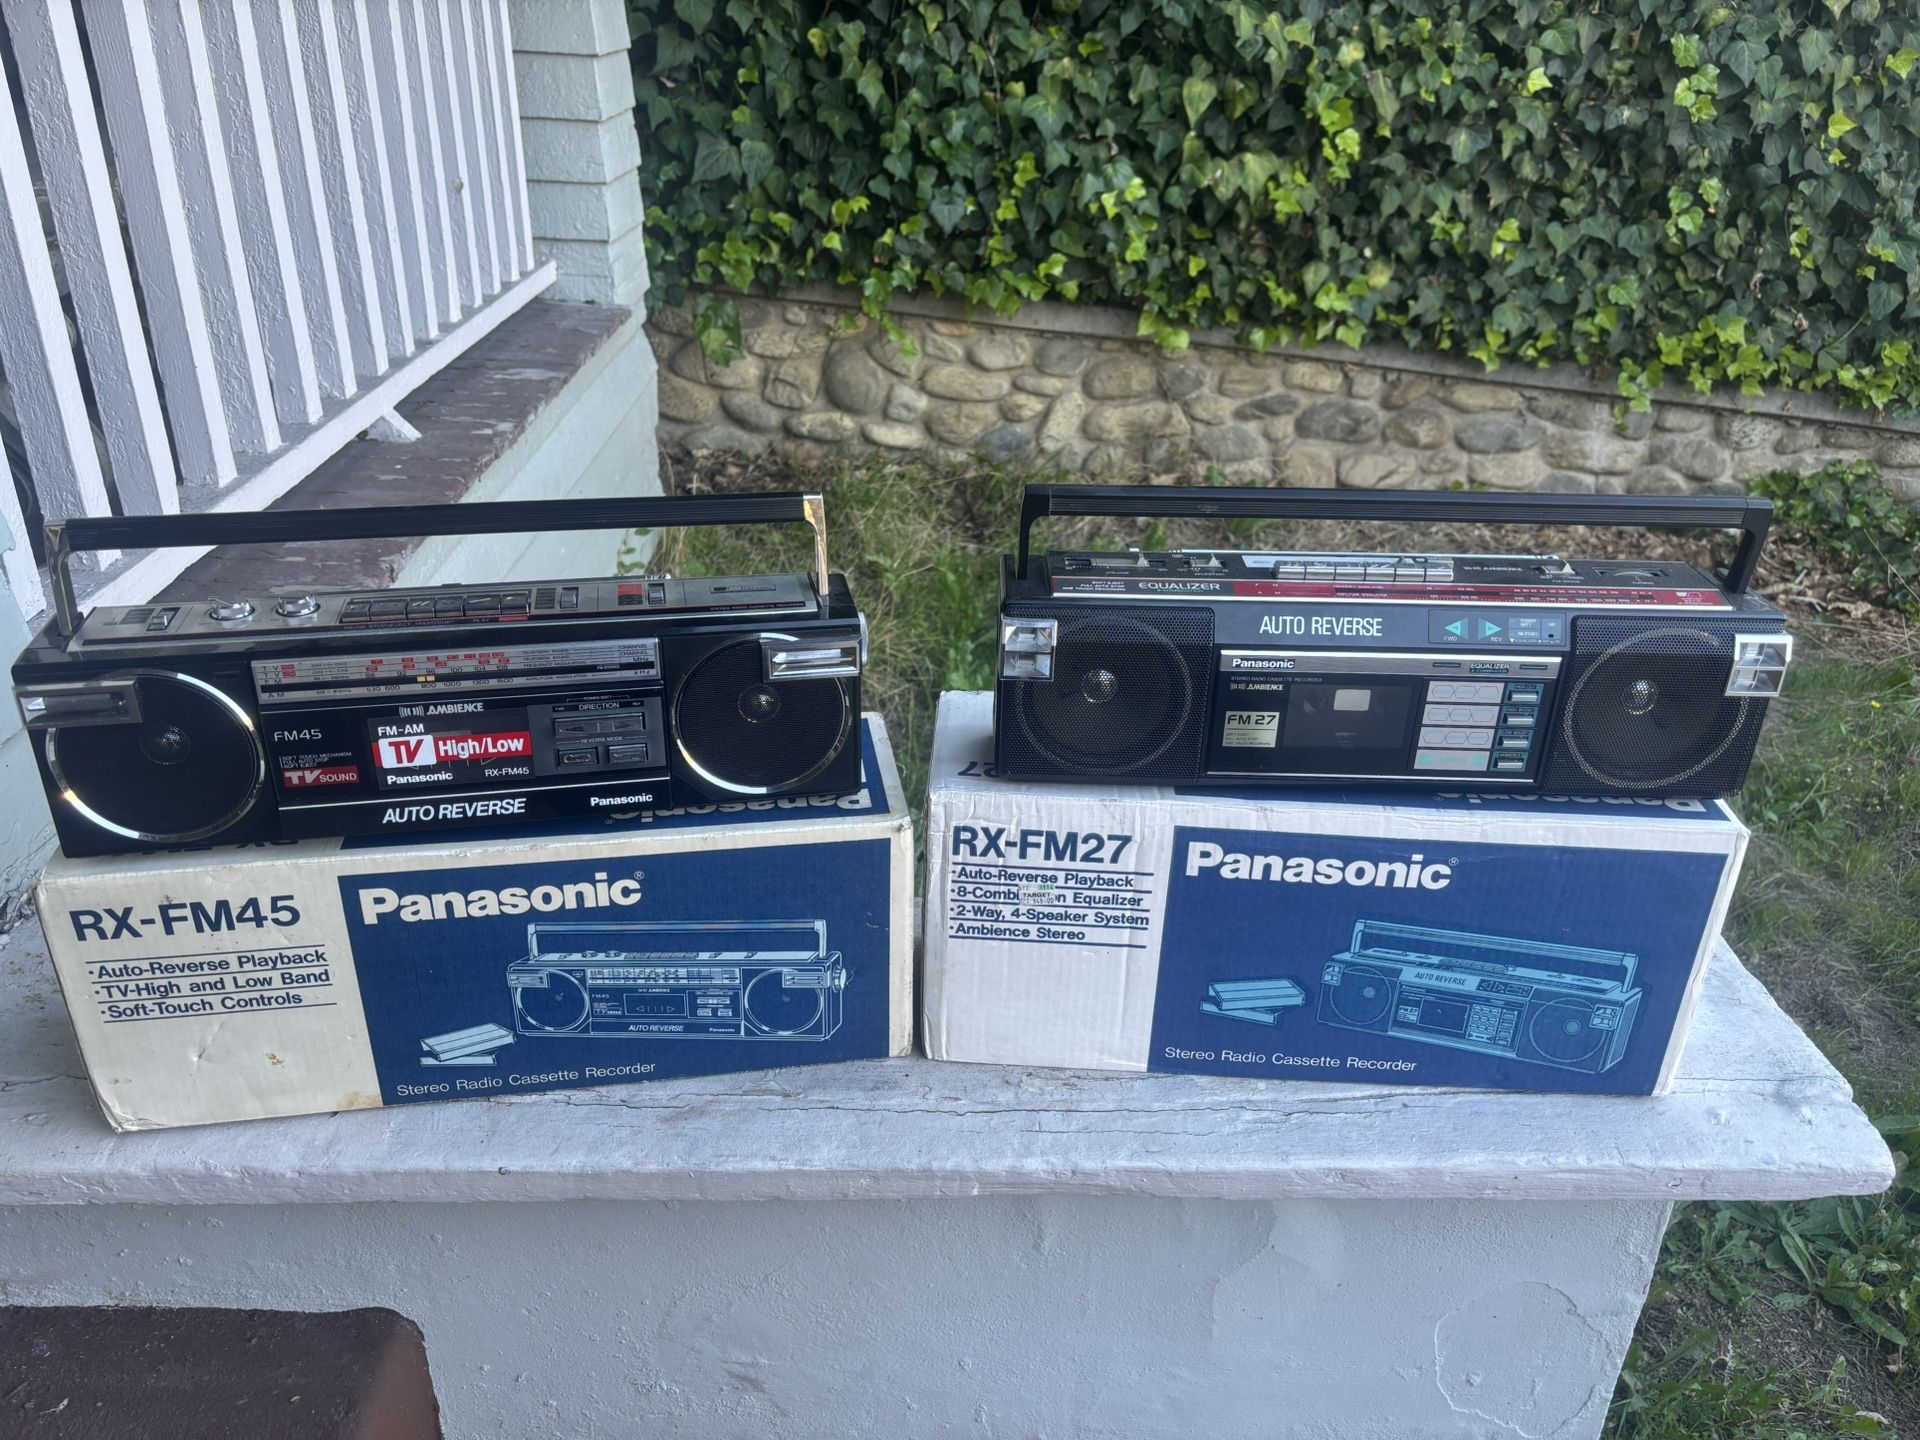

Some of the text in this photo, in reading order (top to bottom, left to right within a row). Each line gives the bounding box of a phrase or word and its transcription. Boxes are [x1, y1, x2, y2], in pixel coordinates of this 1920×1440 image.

[1138, 582, 1220, 591] EQUALIZER
[1259, 615, 1383, 636] AUTO REVERSE
[1232, 658, 1295, 668] Panasonic
[426, 702, 484, 715] AMBIENCE
[579, 702, 620, 711] DIRECTION
[1227, 714, 1277, 725] FM 27
[274, 729, 322, 742] FM45
[377, 724, 425, 737] FM-AM
[388, 737, 524, 765] TV High/Low
[285, 769, 357, 785] TV SOUND
[387, 766, 529, 785] Panasonic RX-FM45
[590, 793, 653, 807] Panasonic
[382, 798, 526, 824] AUTO REVERSE
[952, 825, 1132, 864] RX-FM27
[1186, 841, 1452, 890] Panasonic
[958, 867, 1134, 889] Auto-Reverse Playback
[358, 872, 642, 925] Panasonic
[1073, 892, 1144, 908] Equalizer
[69, 895, 301, 942] RX-FM45
[956, 904, 1150, 927] 2-Way, 4-Speaker System
[955, 923, 1086, 940] Ambience Stereo
[98, 950, 328, 979] Auto-Reverse Playback
[101, 969, 330, 999] TV-High and Low Band
[1414, 972, 1466, 986] AUTO REVERSE
[108, 992, 303, 1019] Soft-Touch Controls
[1165, 1046, 1417, 1072] Stereo Radio Cassette Recorder
[397, 1061, 656, 1096] Stereo Radio Cassette Recorder
